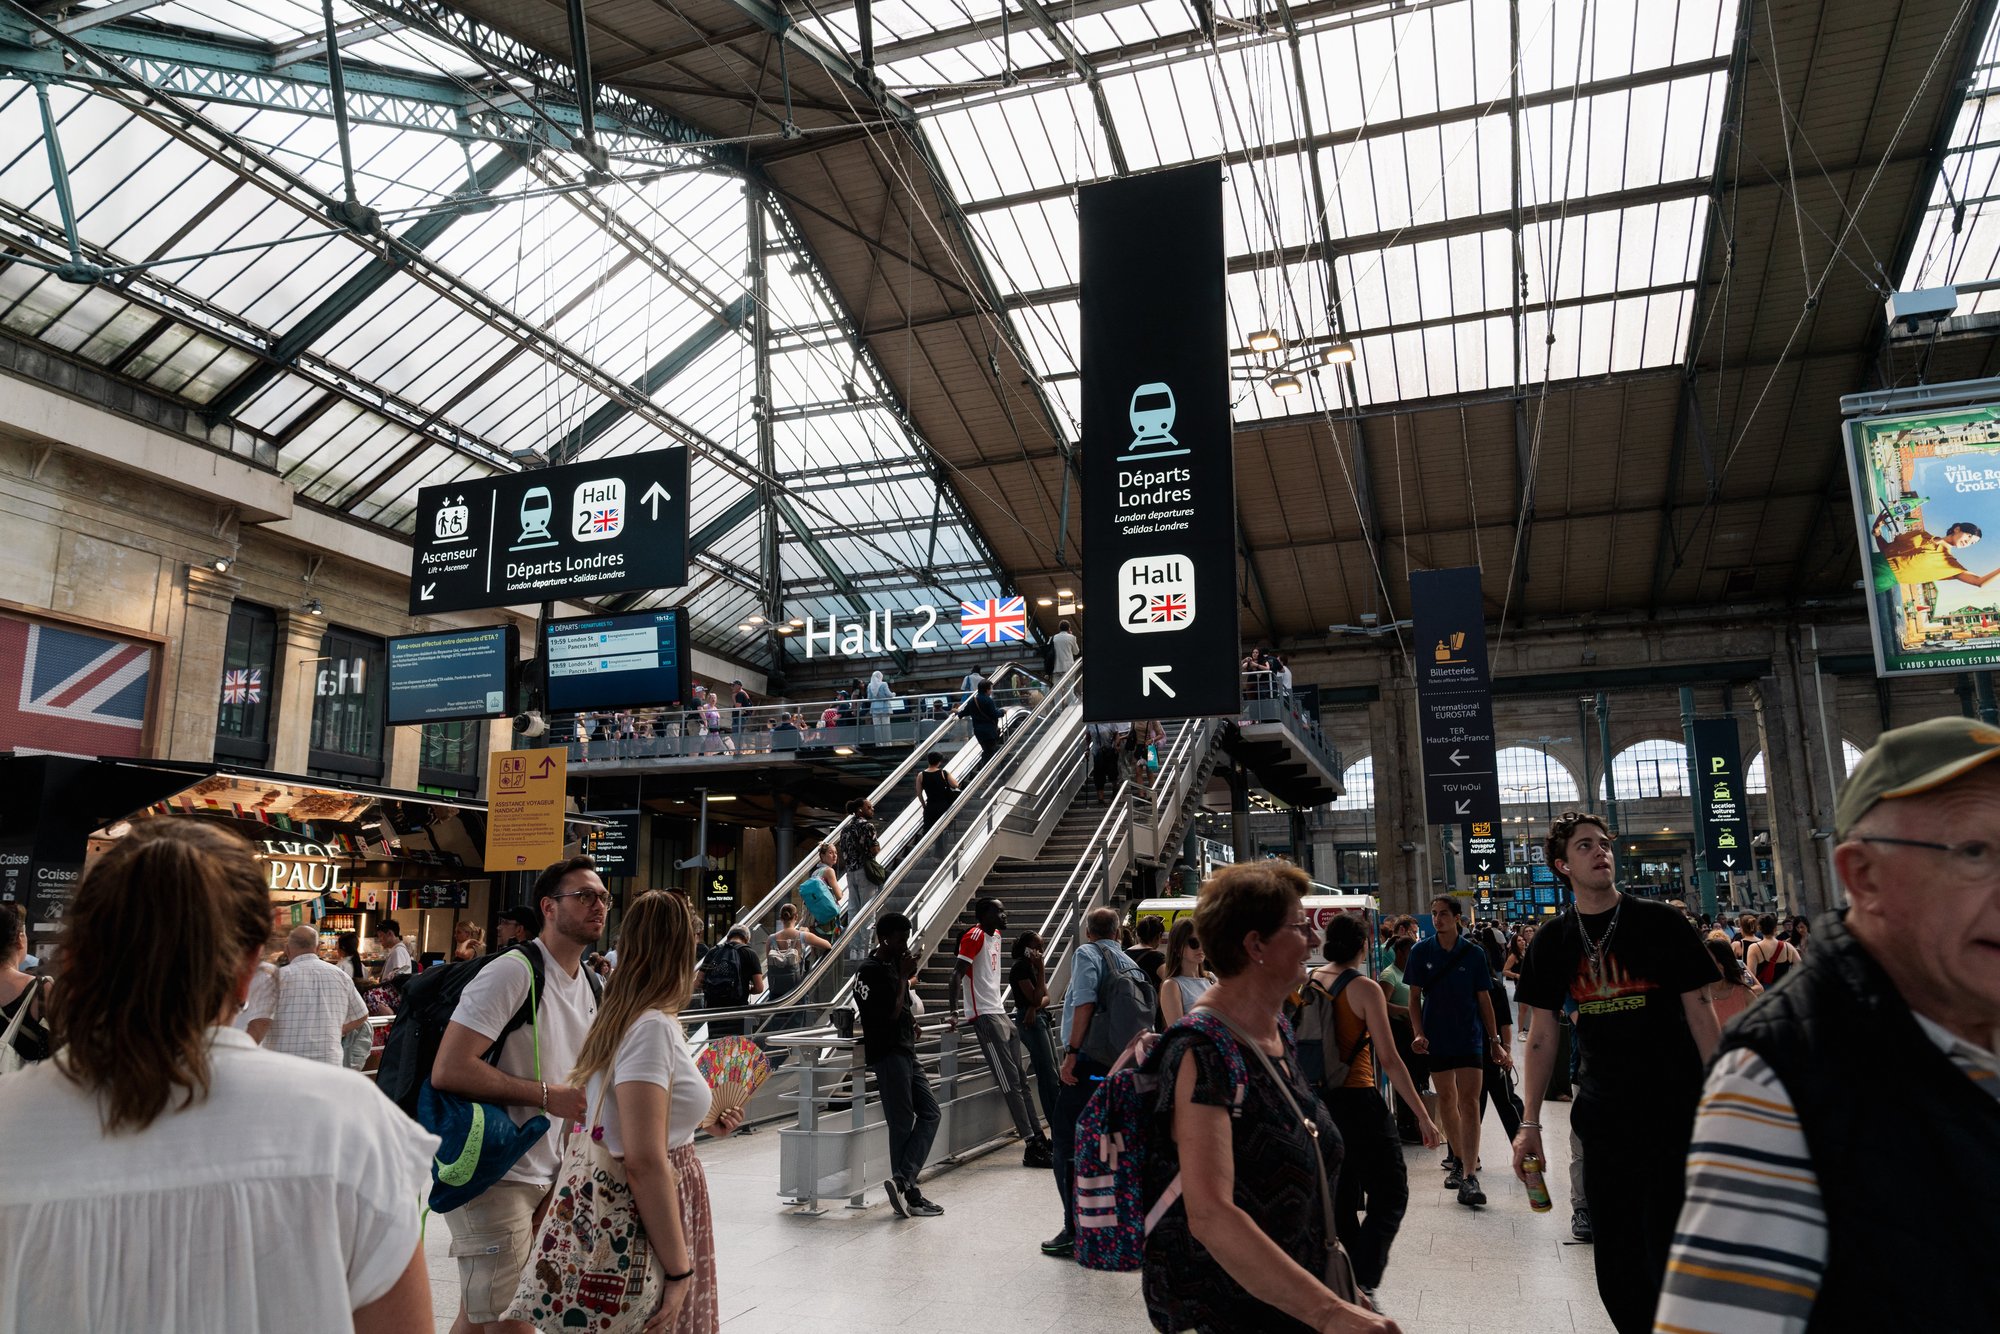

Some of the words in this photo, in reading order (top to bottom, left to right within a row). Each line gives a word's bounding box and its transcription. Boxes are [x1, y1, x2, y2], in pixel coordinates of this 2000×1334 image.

[1119, 468, 1190, 490] Départs
[1944, 470, 1982, 484] Ville
[1956, 480, 2000, 492] Croix-
[582, 485, 617, 504] Hall
[1119, 487, 1191, 507] Londres
[1115, 513, 1146, 523] London
[1148, 508, 1194, 521] departures
[578, 510, 592, 536] 2
[1122, 524, 1153, 535] Salidas
[1155, 521, 1188, 531] Londres
[422, 548, 477, 564] Ascenseur
[428, 566, 438, 574] Lift
[444, 563, 469, 571] Ascensor
[506, 558, 562, 580] Départs
[566, 551, 624, 572] Londres
[507, 581, 531, 591] London
[532, 577, 567, 590] departures
[573, 573, 602, 584] Salidas
[602, 570, 625, 580] Londres
[1132, 563, 1182, 586] Hall
[1128, 594, 1148, 624] 2
[555, 623, 578, 632] DÉPARTS
[806, 608, 897, 658] Hall
[912, 605, 937, 649] 2
[1900, 661, 1926, 669] L'ABUS
[1929, 659, 1965, 668] D'ALCOOL
[1430, 667, 1475, 676] Billetteries
[1431, 702, 1480, 712] International
[1435, 710, 1476, 719] EUROSTAR
[1450, 727, 1464, 735] TER
[1426, 735, 1489, 744] Hauts-de-France
[1712, 757, 1725, 772] P
[1442, 784, 1458, 792] TGV
[1460, 783, 1481, 791] InOui
[0, 853, 29, 865] Caisse
[38, 868, 79, 880] Caisse
[269, 861, 347, 894] PAUL
